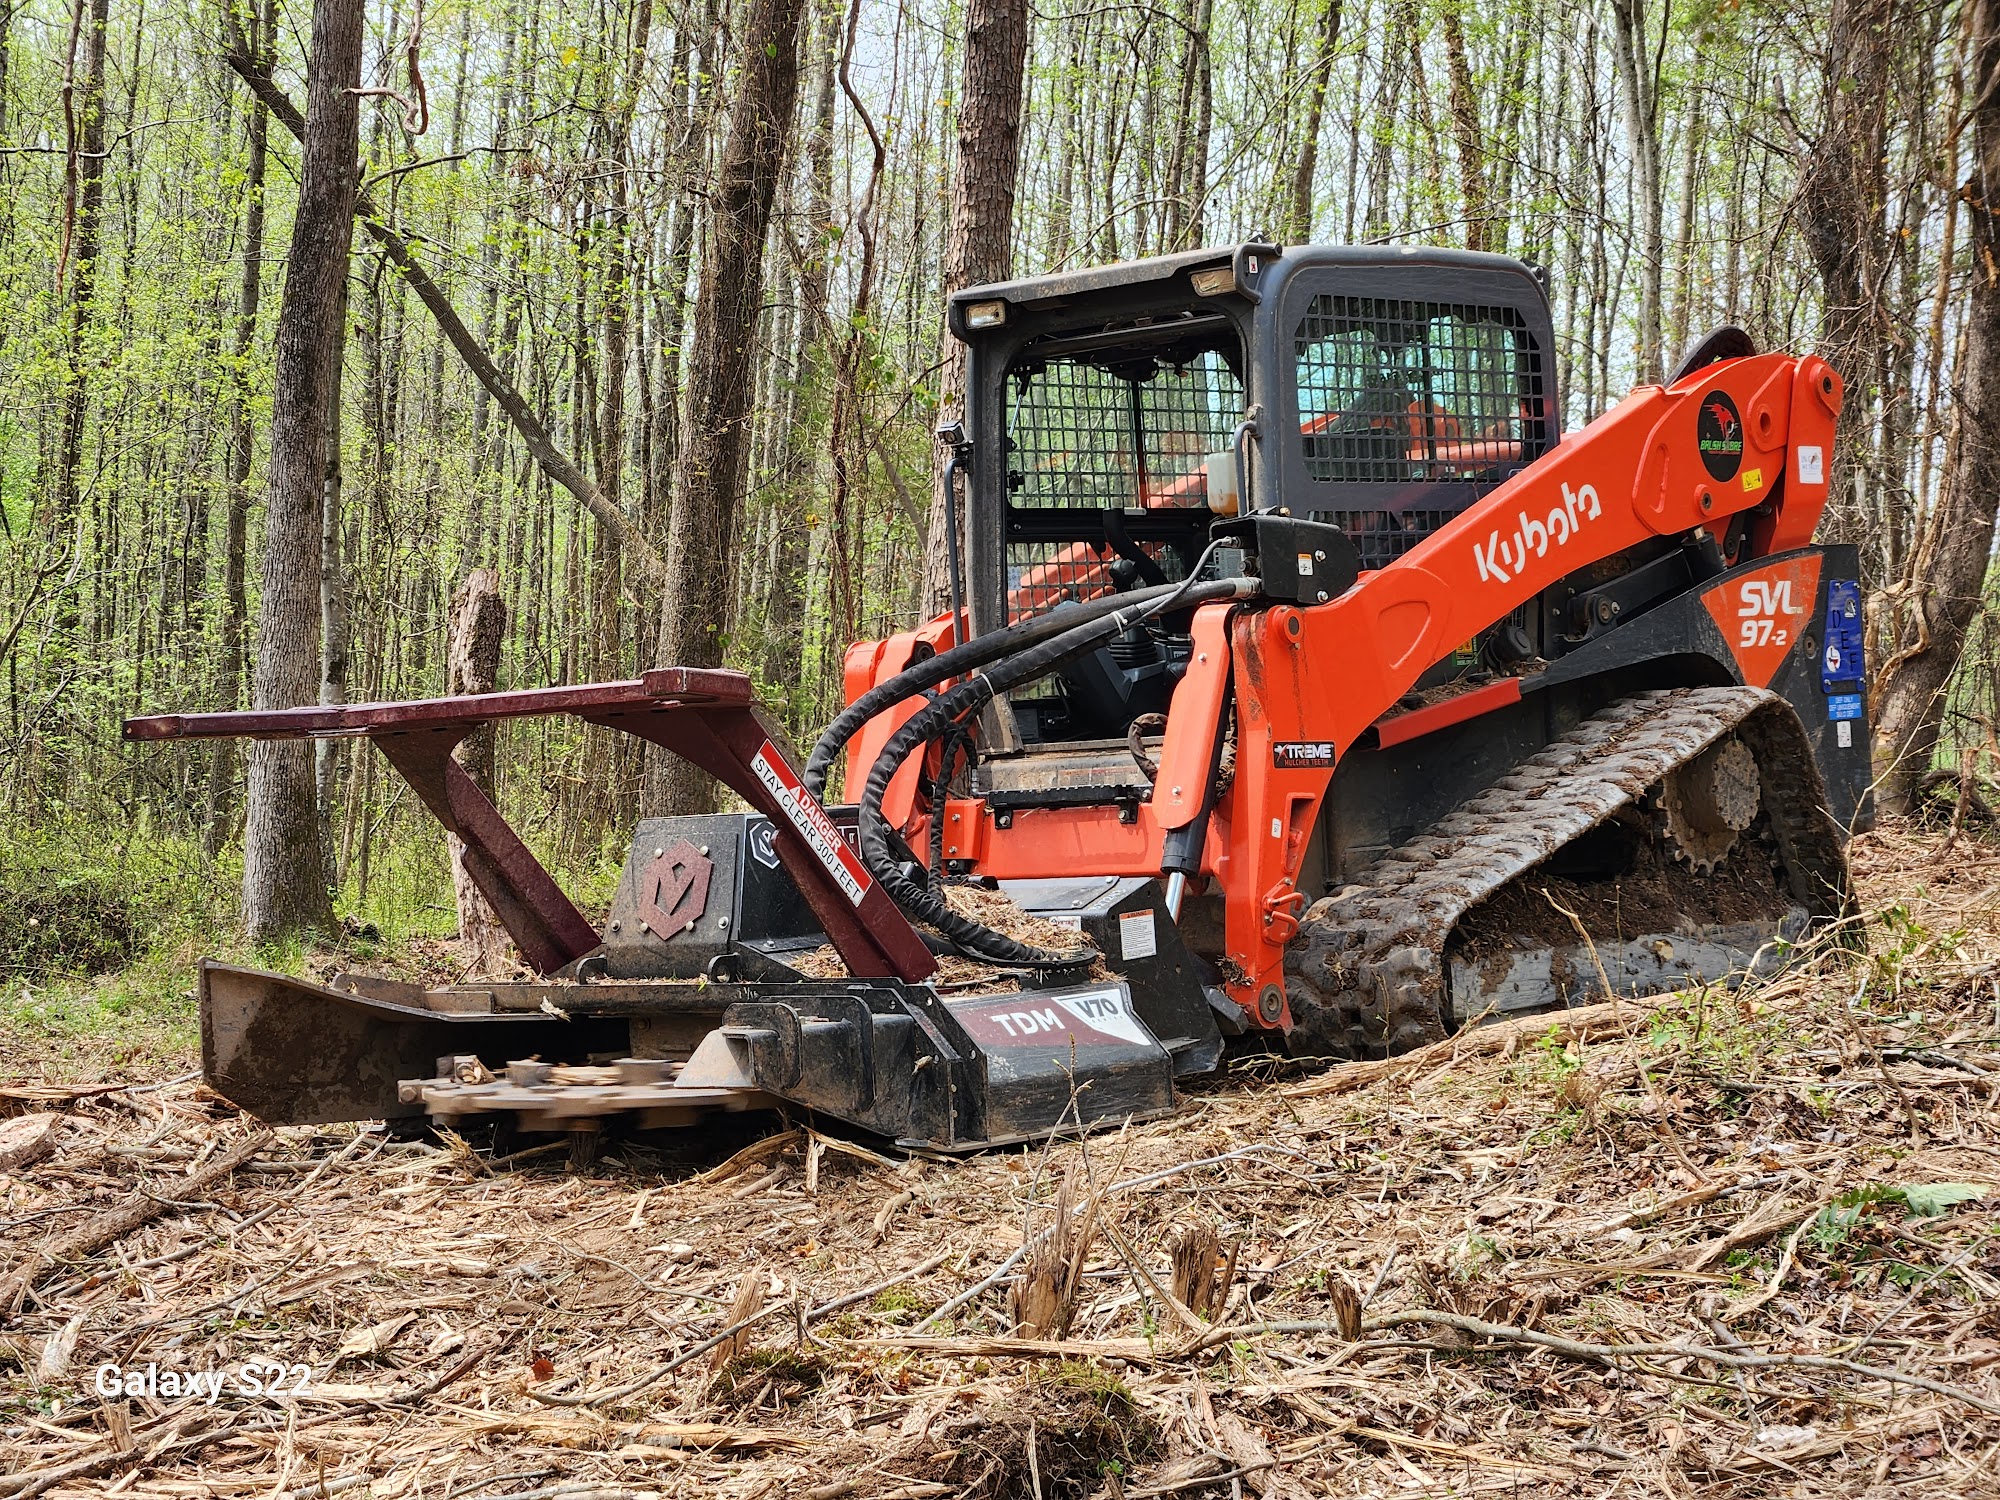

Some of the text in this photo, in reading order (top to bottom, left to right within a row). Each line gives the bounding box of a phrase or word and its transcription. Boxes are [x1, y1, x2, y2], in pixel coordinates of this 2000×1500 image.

[1473, 481, 1602, 583] Kubota
[1738, 580, 1804, 616] SVL
[755, 758, 861, 899] STAY CLEAR 300 FEET
[800, 796, 842, 853] DANGER
[990, 998, 1119, 1036] TDM V70
